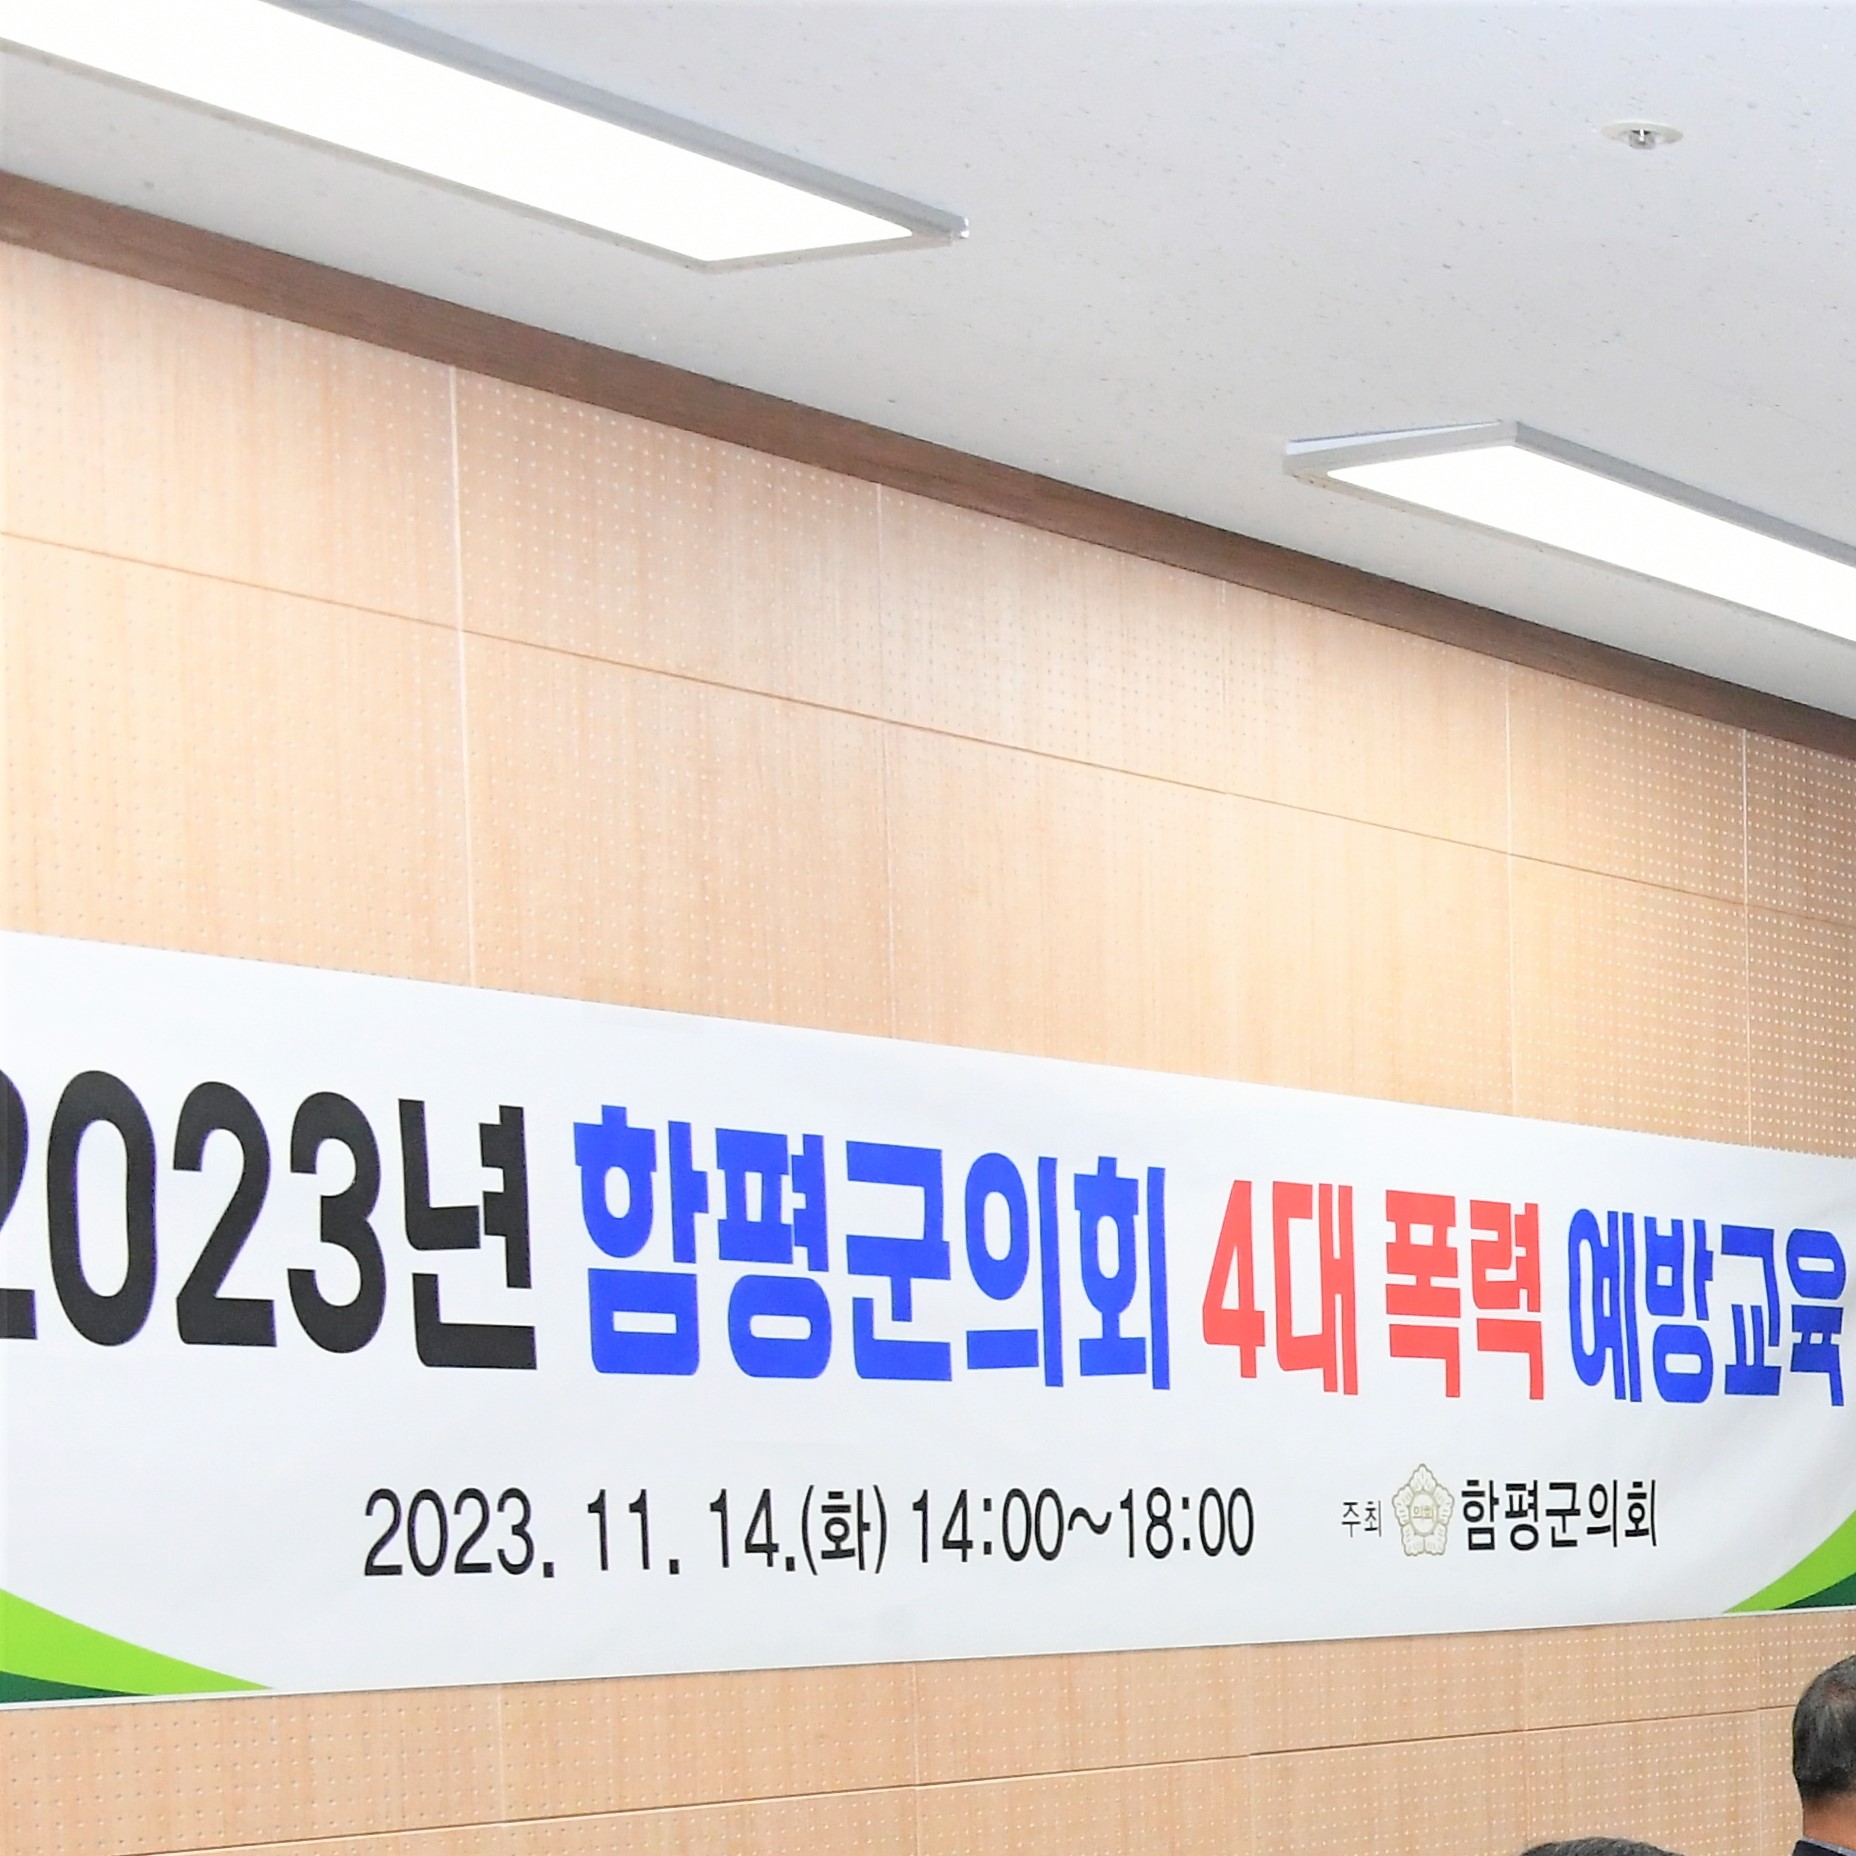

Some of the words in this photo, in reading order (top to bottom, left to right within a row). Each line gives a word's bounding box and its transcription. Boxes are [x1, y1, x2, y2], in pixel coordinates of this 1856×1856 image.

[574, 1104, 1171, 1391] 함평군의회
[1202, 1179, 1359, 1396] 4대
[1385, 1189, 1545, 1401] 폭력
[1567, 1208, 1847, 1407] 예방교육
[364, 1487, 556, 1579] 2023.
[587, 1488, 681, 1576] 11.
[708, 1484, 888, 1577] 14.(화)
[911, 1486, 1255, 1564] 14:00~18:00
[1340, 1500, 1383, 1539] 주최
[1461, 1478, 1658, 1552] 함평군의회
